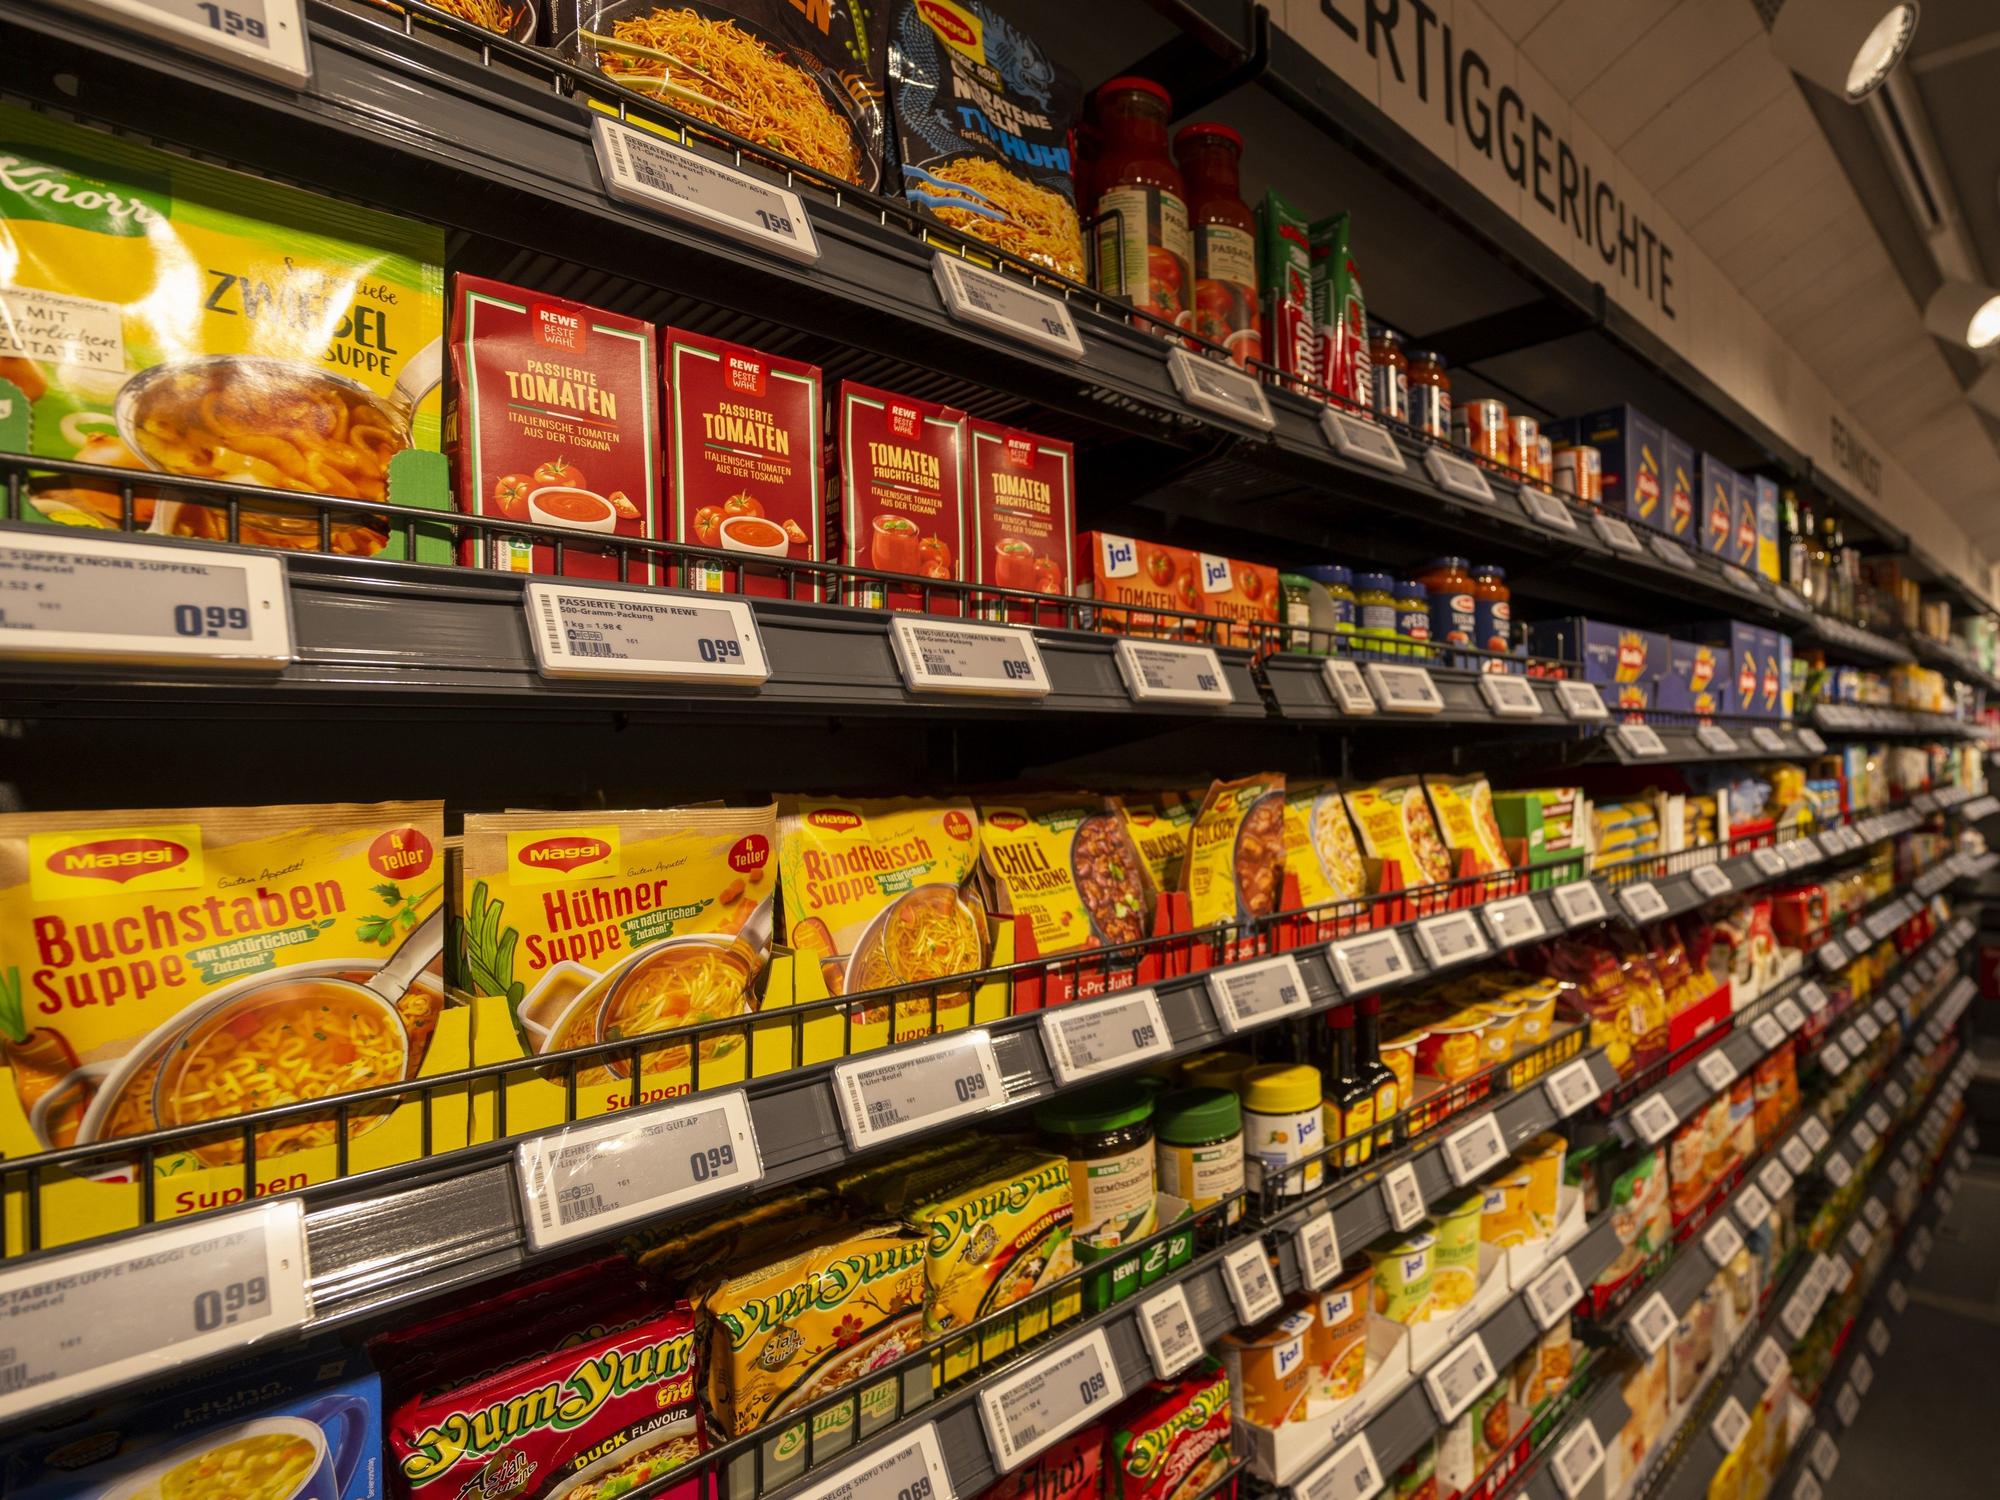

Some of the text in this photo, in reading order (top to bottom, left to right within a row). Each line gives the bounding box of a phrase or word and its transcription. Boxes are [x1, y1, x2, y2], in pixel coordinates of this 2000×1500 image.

[200, 3, 268, 37] 1.59
[924, 6, 971, 42] Maggi
[0, 156, 158, 225] Knorr
[755, 208, 793, 234] 1.59
[27, 306, 70, 323] MIT
[540, 310, 579, 329] REWE
[544, 324, 575, 339] BESTE
[544, 333, 576, 349] WAHL
[527, 359, 597, 387] PASSIERTE
[730, 358, 760, 374] REWE
[733, 370, 756, 384] BESTE
[505, 370, 617, 421] TOMATEN
[733, 379, 757, 392] WAHL
[719, 402, 774, 426] PASSIERTE
[892, 405, 917, 420] REWE
[508, 412, 620, 443] ITALIENISCHE TOMATEN
[524, 426, 610, 451] AUS DER TOSKANA
[702, 412, 789, 456] TOMATEN
[1008, 439, 1031, 451] REWE
[704, 451, 792, 477] ITALIENISCHE TOMATEN
[868, 442, 940, 479] TOMATEN
[716, 464, 784, 484] AUS DER TOSKANA
[873, 466, 940, 490] FRUCHTFLEISCH
[871, 486, 942, 509] ITALIENISCHE TOMATEN
[992, 472, 1051, 504] TOMATEN
[880, 497, 936, 515] AUS DER TOSKANA
[995, 495, 1051, 515] FRUCHTFLEISCH
[10, 551, 68, 564] SUPPE
[74, 556, 134, 570] KNORR
[1108, 543, 1132, 571] ja!
[1205, 562, 1226, 587] ja!
[559, 597, 698, 617] PASSIERTE TOMATEN REWE
[1116, 586, 1177, 611] TOMATEN
[174, 603, 248, 637] 0.99
[560, 606, 654, 622] 500-Gramm-Packung
[1215, 601, 1264, 622] TOMATEN
[571, 621, 585, 630] kg
[595, 623, 615, 631] 1.98
[698, 638, 741, 663] 0.99
[1003, 660, 1030, 680] 0.99
[815, 814, 859, 826] Maggi
[391, 833, 404, 851] 4
[529, 843, 601, 862] Maggi
[745, 838, 753, 852] 4
[64, 846, 173, 871] Maggi
[378, 847, 425, 871] Teller
[734, 849, 766, 868] Teller
[803, 836, 933, 882] Rindfleisch
[806, 875, 877, 910] Suppe
[542, 879, 668, 933] Hühner
[627, 904, 696, 932] Mit natürlichen
[32, 879, 347, 969] Buchstaben
[194, 926, 309, 963] Mit natürlichen
[525, 924, 622, 970] Suppe
[32, 953, 187, 1014] Suppe
[1132, 1025, 1156, 1048] 0.99
[857, 1065, 896, 1081] RINDFLEISCH
[955, 1073, 985, 1102] 0.99
[1297, 1117, 1315, 1143] ja!
[690, 1144, 734, 1182] 0.99
[1098, 1164, 1120, 1175] REWE
[175, 1172, 309, 1214] Suppen
[1015, 1212, 1052, 1249] CHICKEN
[128, 1248, 185, 1275] MAGGI
[1405, 1255, 1423, 1278] ja!
[193, 1276, 267, 1334] 0.99
[1326, 1295, 1347, 1322] ja!
[1279, 1342, 1299, 1373] ja!
[1080, 1372, 1106, 1405] 0.69
[401, 1331, 696, 1488] YumYum
[574, 1408, 688, 1471] DUCK FLAVOUR
[853, 1447, 913, 1488] SHOYU YUM YUM
